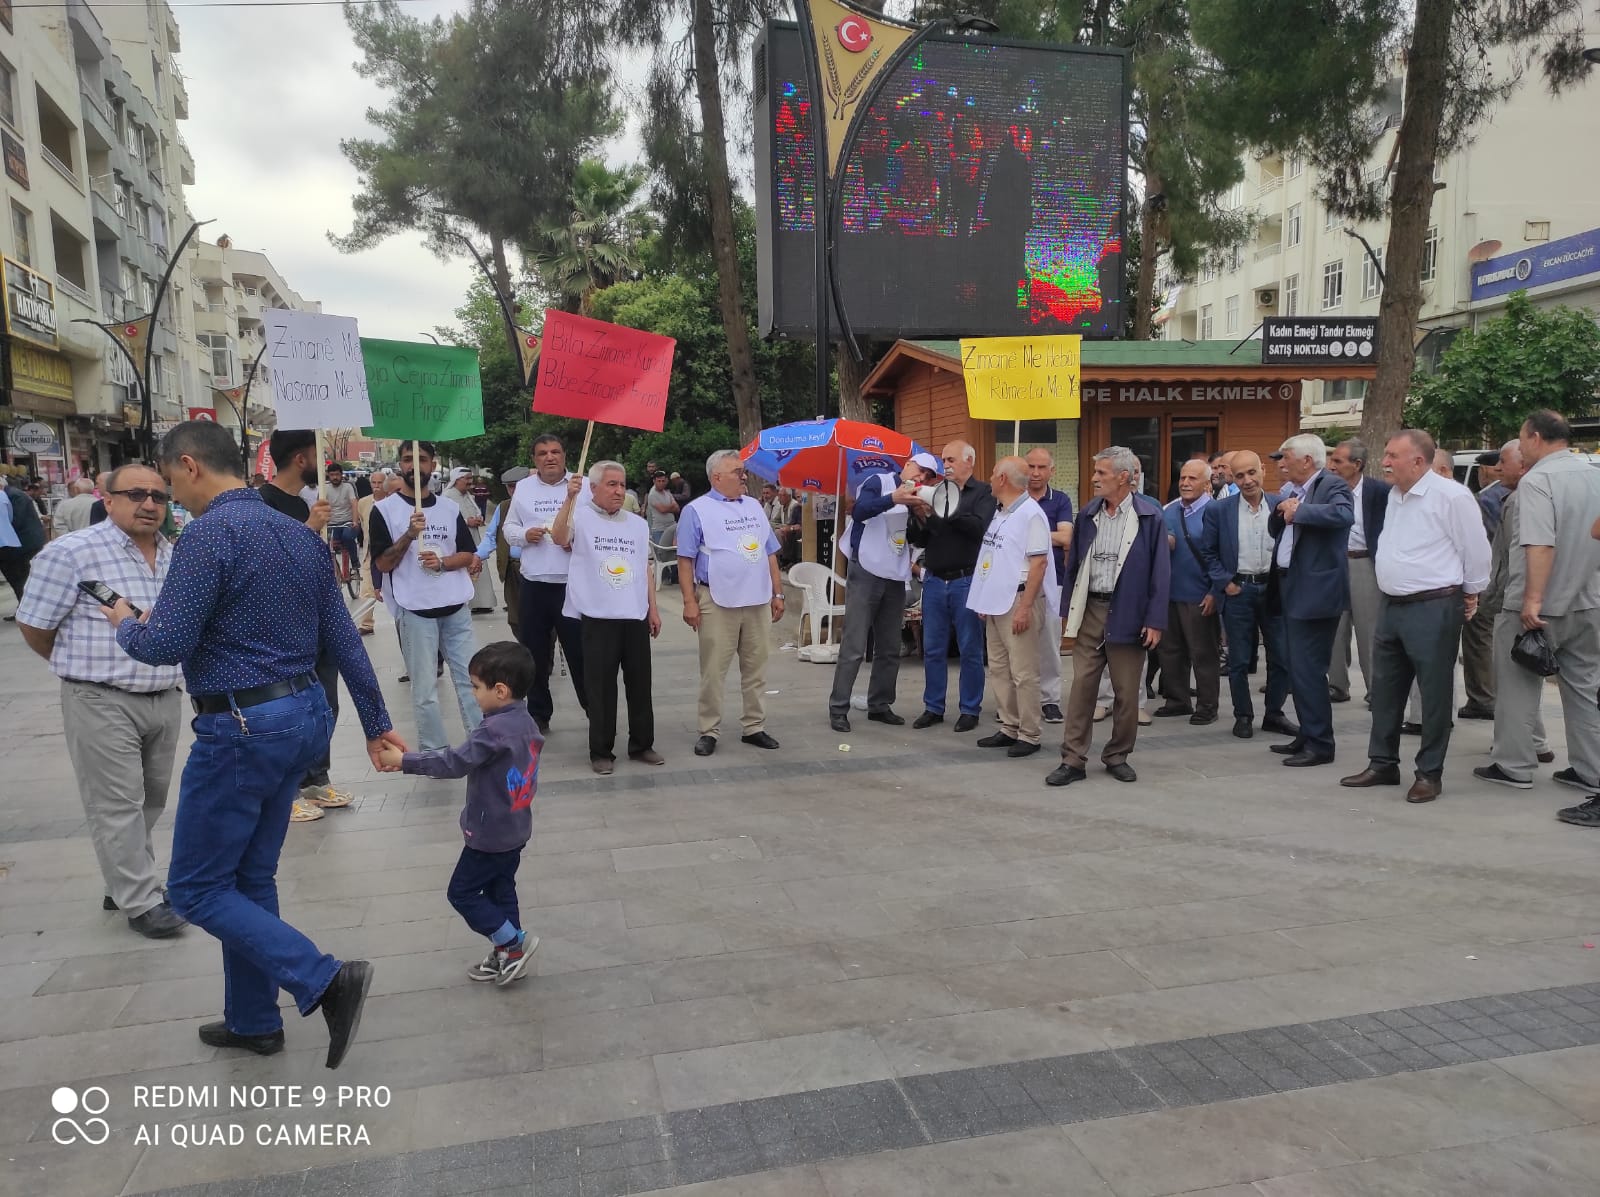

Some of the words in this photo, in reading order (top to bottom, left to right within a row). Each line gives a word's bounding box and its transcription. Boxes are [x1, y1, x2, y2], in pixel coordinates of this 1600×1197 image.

[1269, 324, 1292, 337] Kadın
[1293, 324, 1318, 340] Emeği
[1320, 324, 1344, 337] Tandır
[1345, 325, 1374, 340] Ekmeği
[1023, 345, 1042, 368] Me
[1268, 344, 1292, 357] SATIŞ
[1293, 344, 1329, 356] NOKTASI
[1082, 387, 1111, 402] PE
[1120, 387, 1184, 401] HALK
[1191, 386, 1273, 401] EKMEK
